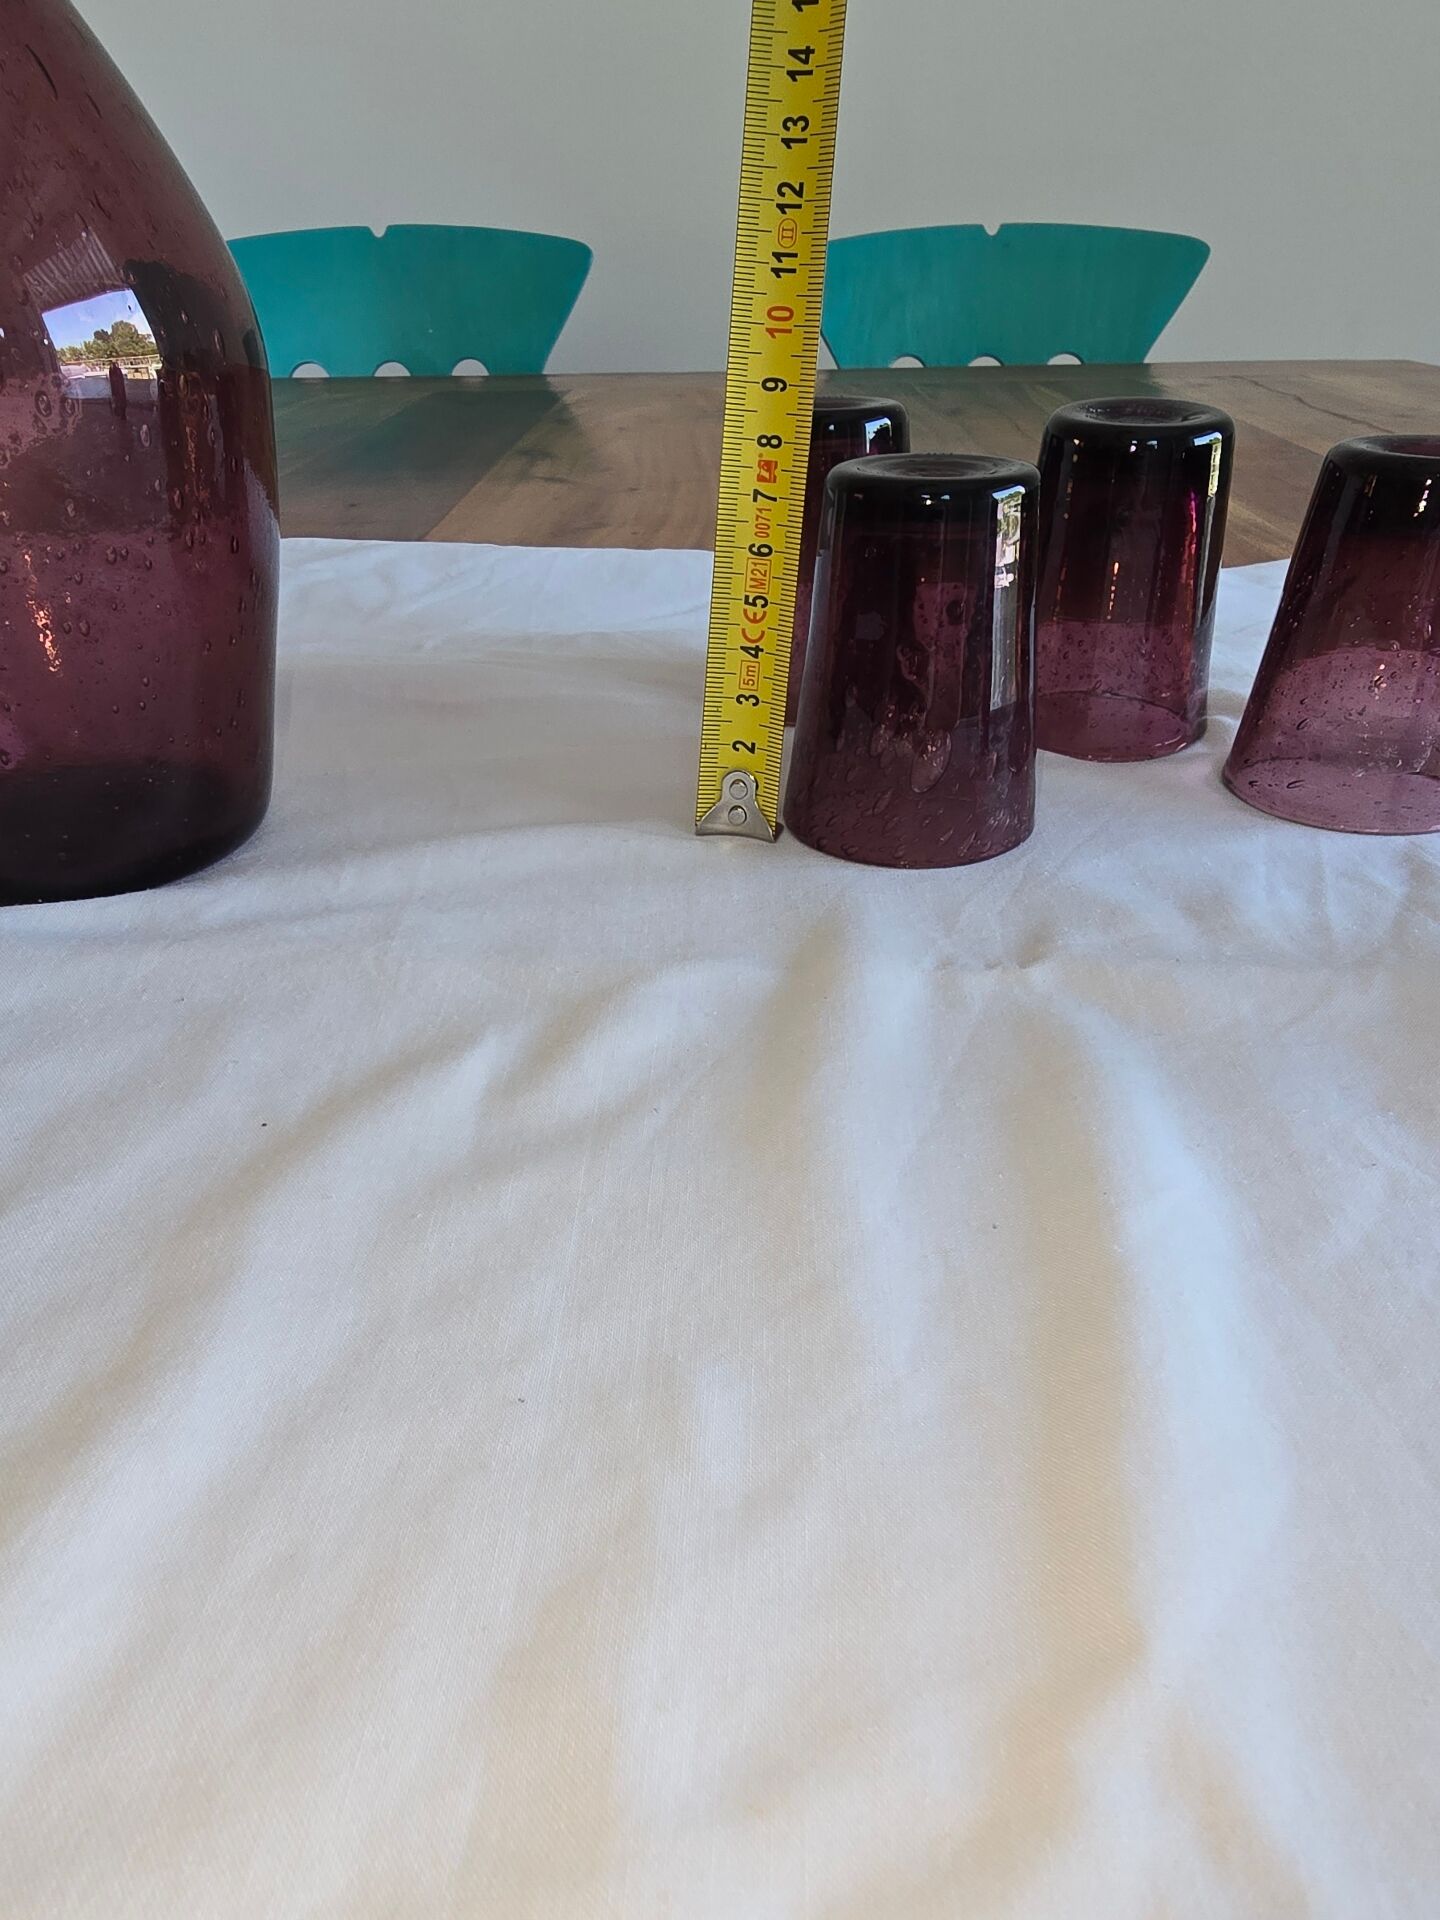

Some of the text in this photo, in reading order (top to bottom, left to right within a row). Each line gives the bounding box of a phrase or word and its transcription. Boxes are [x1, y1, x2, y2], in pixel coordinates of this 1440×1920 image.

[792, 0, 819, 12] 1
[786, 46, 815, 82] 14
[781, 115, 809, 150] 13
[776, 181, 804, 215] 12
[770, 251, 798, 278] 11
[765, 305, 795, 339] 10
[761, 377, 787, 392] 9
[757, 434, 782, 449] 8
[753, 488, 777, 503] 7
[755, 507, 771, 538] 0071
[748, 542, 773, 557] 6
[749, 560, 768, 590] M21
[744, 594, 768, 609] 5
[740, 644, 764, 659] 4
[742, 665, 756, 686] 5m
[736, 693, 760, 707] 3
[732, 739, 755, 754] 2
